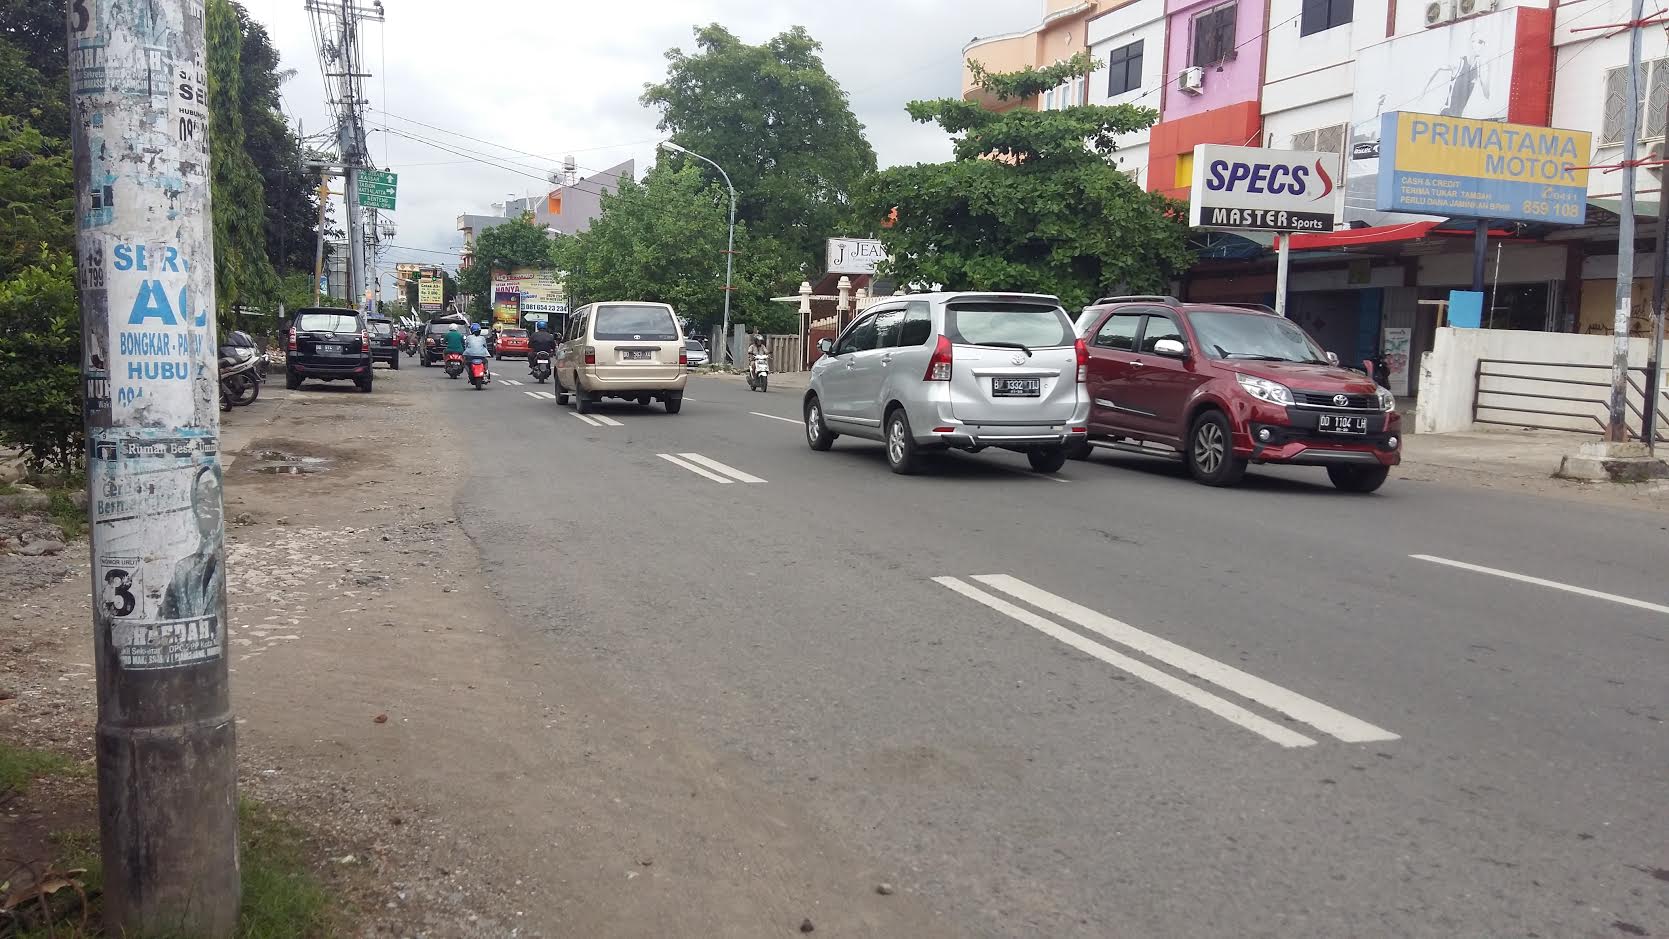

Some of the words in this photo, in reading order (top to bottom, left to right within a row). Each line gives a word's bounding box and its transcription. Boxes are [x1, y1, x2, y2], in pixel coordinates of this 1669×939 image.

[1411, 120, 1578, 158] PRIMATAMA
[1485, 154, 1576, 181] MOTOR
[1206, 160, 1309, 195] SPECS
[1401, 177, 1423, 185] CASH
[1432, 179, 1461, 188] CREDIT
[1400, 196, 1426, 205] PERLU
[1427, 198, 1448, 207] DANA
[1401, 187, 1429, 196] TERIMA
[1432, 189, 1458, 198] TUKAR
[1523, 201, 1549, 214] 859
[1553, 203, 1578, 217] 108
[1212, 208, 1288, 227] MASTER
[1291, 217, 1323, 229] Sports
[120, 332, 170, 356] BONGKAR
[994, 381, 999, 390] B
[1007, 380, 1023, 390] 1332
[1320, 416, 1330, 426] DD
[1335, 417, 1352, 428] 1104
[1356, 418, 1367, 429] LH
[105, 569, 135, 617] 3
